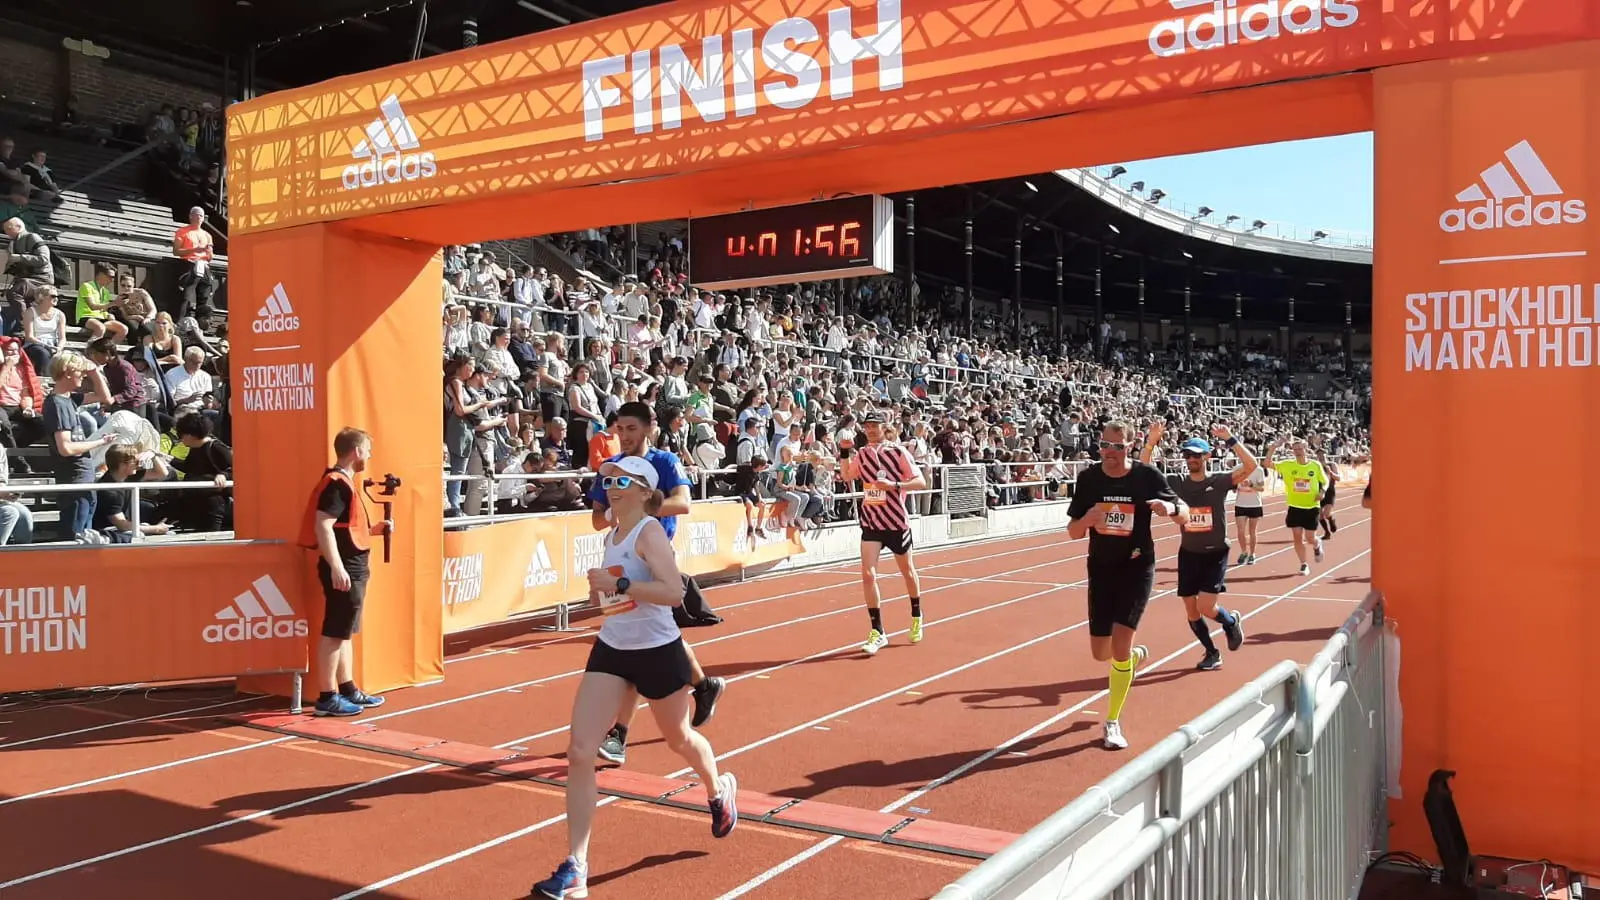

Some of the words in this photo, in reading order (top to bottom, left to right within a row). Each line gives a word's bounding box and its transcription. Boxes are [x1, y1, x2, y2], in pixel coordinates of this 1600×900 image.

[1148, 0, 1359, 57] adidas
[582, 0, 904, 142] FINISH
[342, 149, 437, 190] adidas
[1439, 196, 1587, 232] adidas
[252, 313, 300, 332] adidas
[1406, 283, 1600, 332] STOCKHOL
[1405, 326, 1600, 371] MARATHO
[243, 363, 314, 388] STOCKHOLM
[243, 387, 314, 411] MARATHON
[1104, 512, 1126, 524] 7589
[202, 616, 308, 643] adidas
